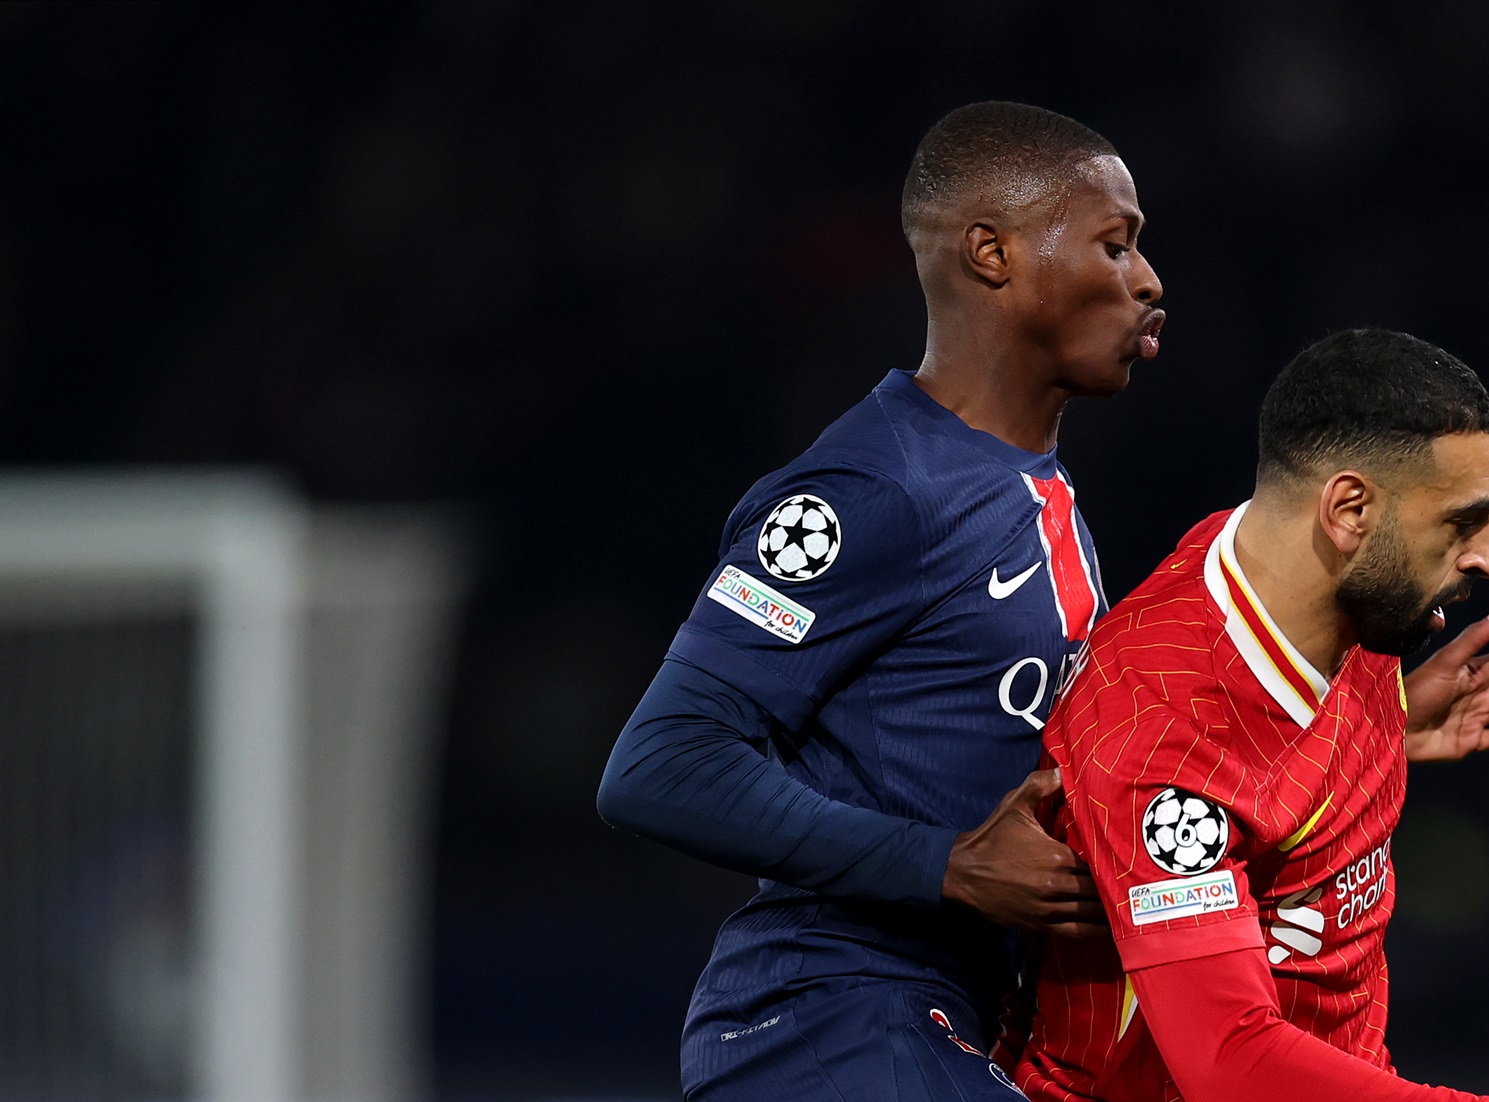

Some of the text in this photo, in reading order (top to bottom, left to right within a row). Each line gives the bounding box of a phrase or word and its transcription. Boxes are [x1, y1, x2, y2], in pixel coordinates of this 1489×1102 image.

[724, 567, 741, 580] UEFA
[716, 575, 807, 634] FOUNDATION
[764, 620, 798, 641] for children
[1174, 812, 1198, 848] 6
[1132, 887, 1151, 898] UEFA
[1133, 882, 1234, 912] FOUNDATION
[1203, 899, 1235, 911] for children
